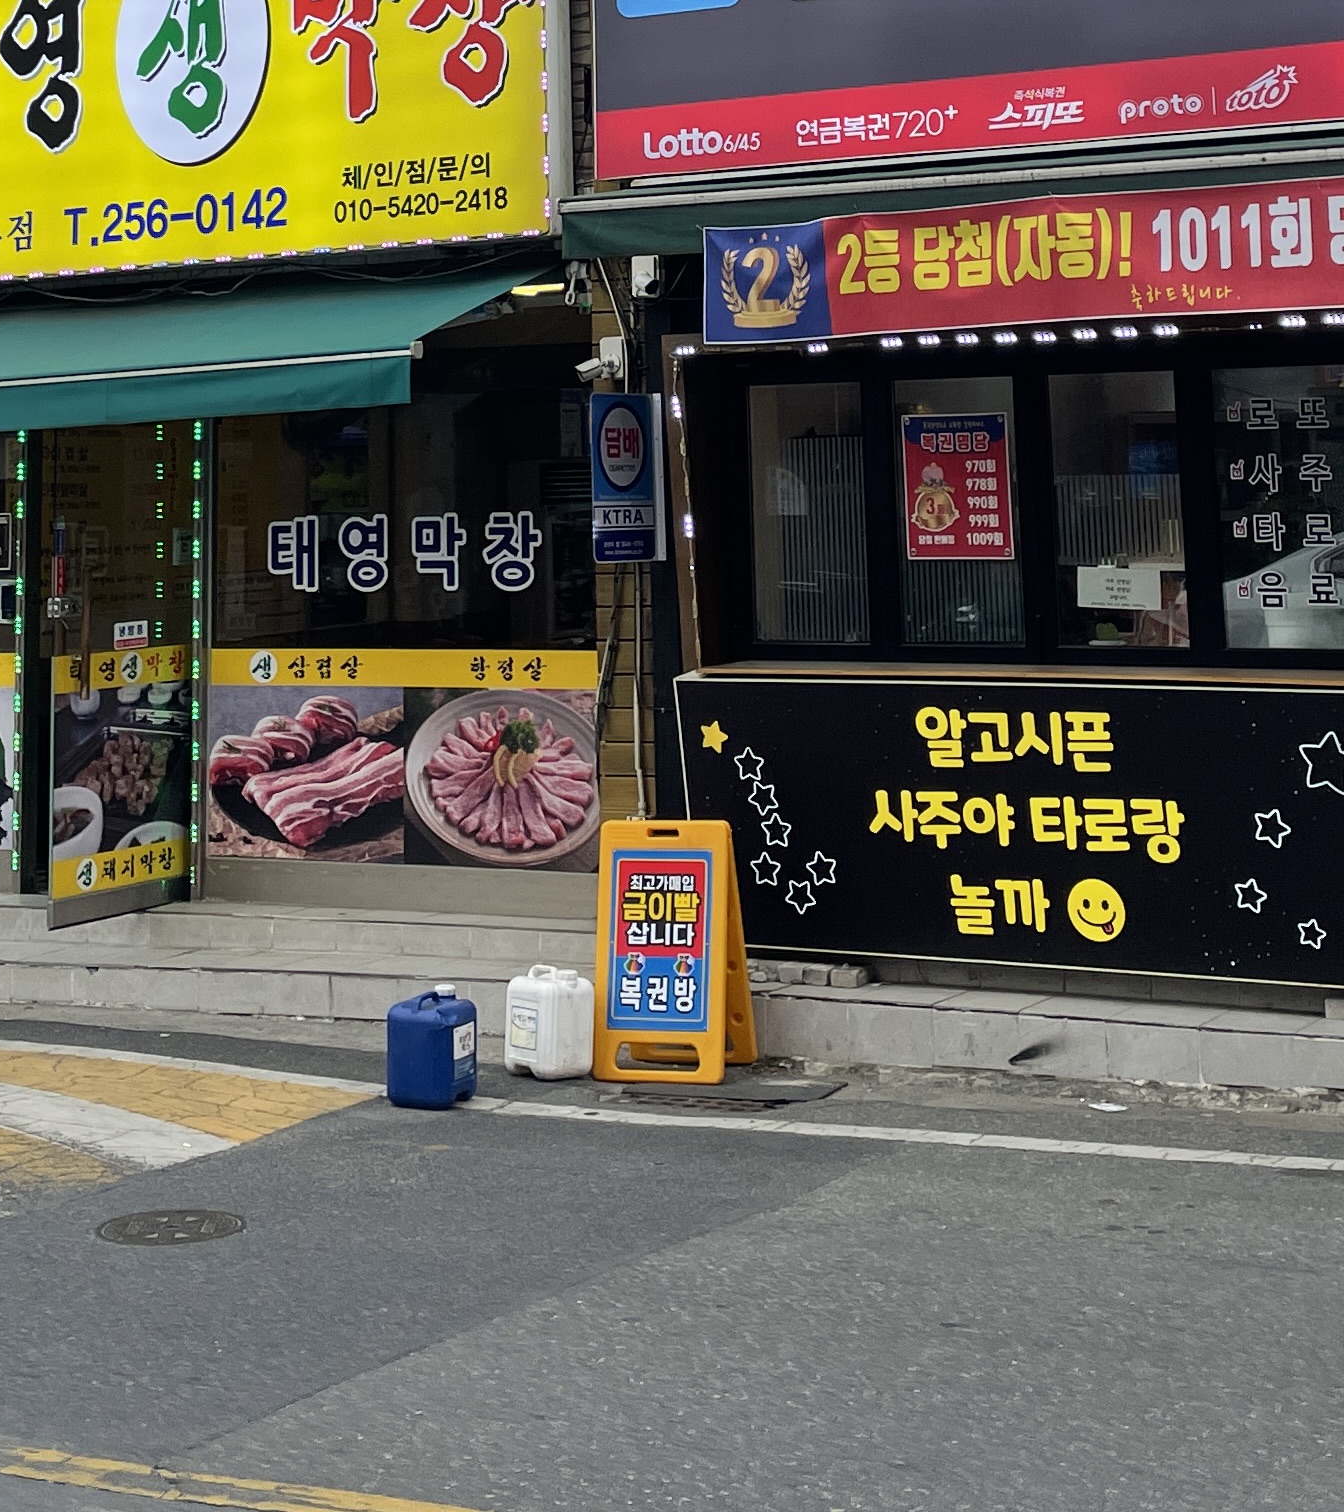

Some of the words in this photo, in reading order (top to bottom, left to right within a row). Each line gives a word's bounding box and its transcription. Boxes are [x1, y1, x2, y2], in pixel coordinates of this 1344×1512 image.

[987, 100, 1085, 131] 스피또
[1118, 93, 1204, 125] proto
[340, 151, 492, 192] 체/인/점/문/의
[334, 186, 509, 225] 010-5420-2418
[836, 228, 902, 296] 2등
[912, 206, 1133, 290] 당첨(자동)!
[1151, 196, 1314, 273] 1011회
[1246, 397, 1330, 430] 로또
[604, 427, 640, 460] 담배
[920, 431, 990, 453] 복권명당
[1248, 453, 1333, 493] 사주
[602, 508, 645, 525] KTRA
[1253, 512, 1337, 551] 타로
[266, 511, 544, 594] 태영막창
[1257, 571, 1340, 609] 음료
[288, 654, 364, 681] 삼겹살
[468, 654, 548, 682] 항정살
[914, 705, 1115, 773] 알고시픈
[869, 789, 1015, 850] 사주야
[1031, 795, 1185, 865] 타로랑
[102, 846, 176, 882] 돼지막창
[629, 874, 695, 892] 최고가매입
[622, 891, 701, 924] 금이빨
[950, 874, 1051, 936] 놀까
[626, 922, 696, 948] 삽니다
[619, 976, 697, 1014] 복권방
